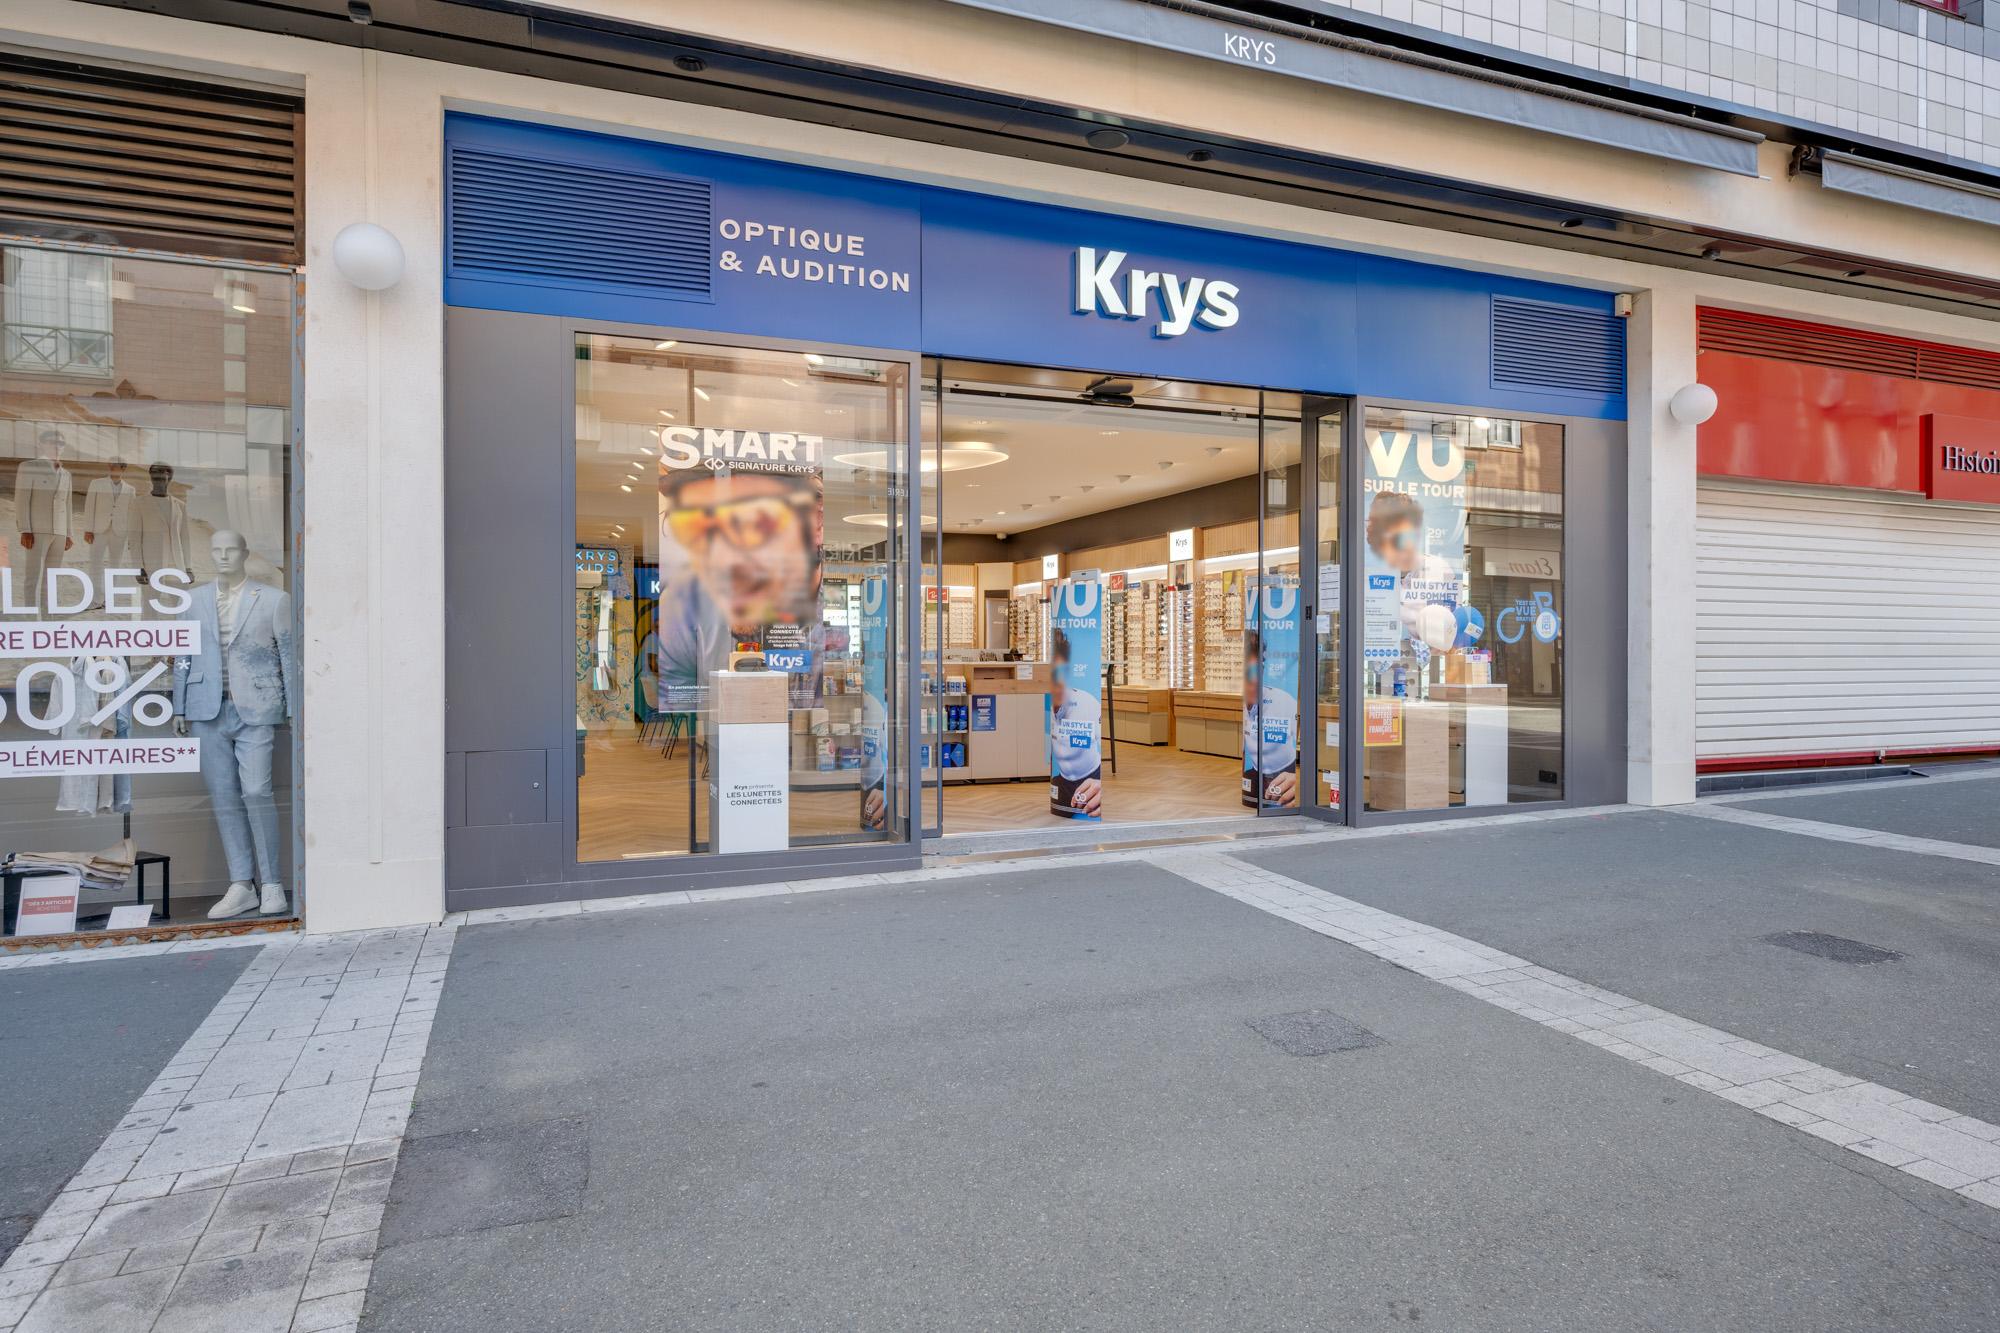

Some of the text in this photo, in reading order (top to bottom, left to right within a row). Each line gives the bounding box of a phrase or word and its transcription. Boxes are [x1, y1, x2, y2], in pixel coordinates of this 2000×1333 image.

[1224, 32, 1276, 65] KRYS
[719, 219, 865, 257] OPTIQUE
[719, 250, 910, 293] & AUDITION
[1075, 246, 1240, 337] Krys
[660, 427, 824, 470] SMART
[1364, 431, 1466, 483] VU
[1942, 445, 2000, 475] Histoi
[728, 461, 815, 474] SIGNATURE KRYS
[1364, 479, 1465, 498] SUR LE TOUR
[1373, 576, 1391, 588] Krys
[1429, 582, 1459, 591] STYLE
[1405, 591, 1458, 601] AU SOMMET
[1516, 606, 1537, 616] VUE
[1068, 618, 1097, 628] TOUR
[1263, 621, 1295, 630] TOUR
[33, 624, 191, 650] DÉMARQUE
[769, 653, 804, 669] Krys
[1072, 737, 1089, 747] Krys
[1267, 732, 1284, 742] Krys
[743, 790, 782, 798] LUNETTES
[730, 797, 783, 806] CONNECTÉES
